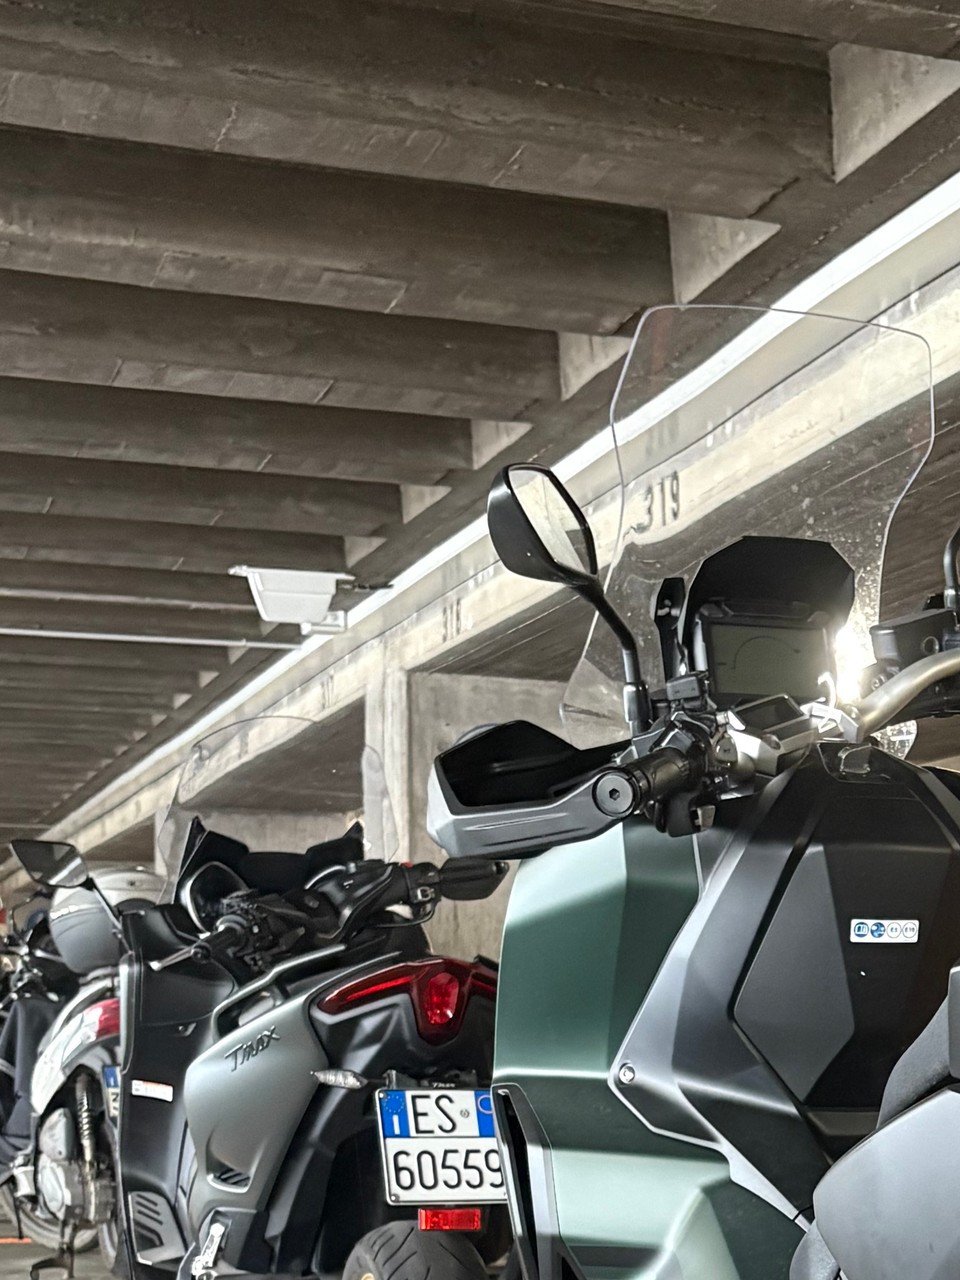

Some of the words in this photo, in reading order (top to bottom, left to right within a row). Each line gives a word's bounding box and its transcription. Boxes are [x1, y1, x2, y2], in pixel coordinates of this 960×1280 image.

[635, 470, 680, 534] 319
[411, 1094, 457, 1134] ES
[393, 1149, 505, 1190] 60559
